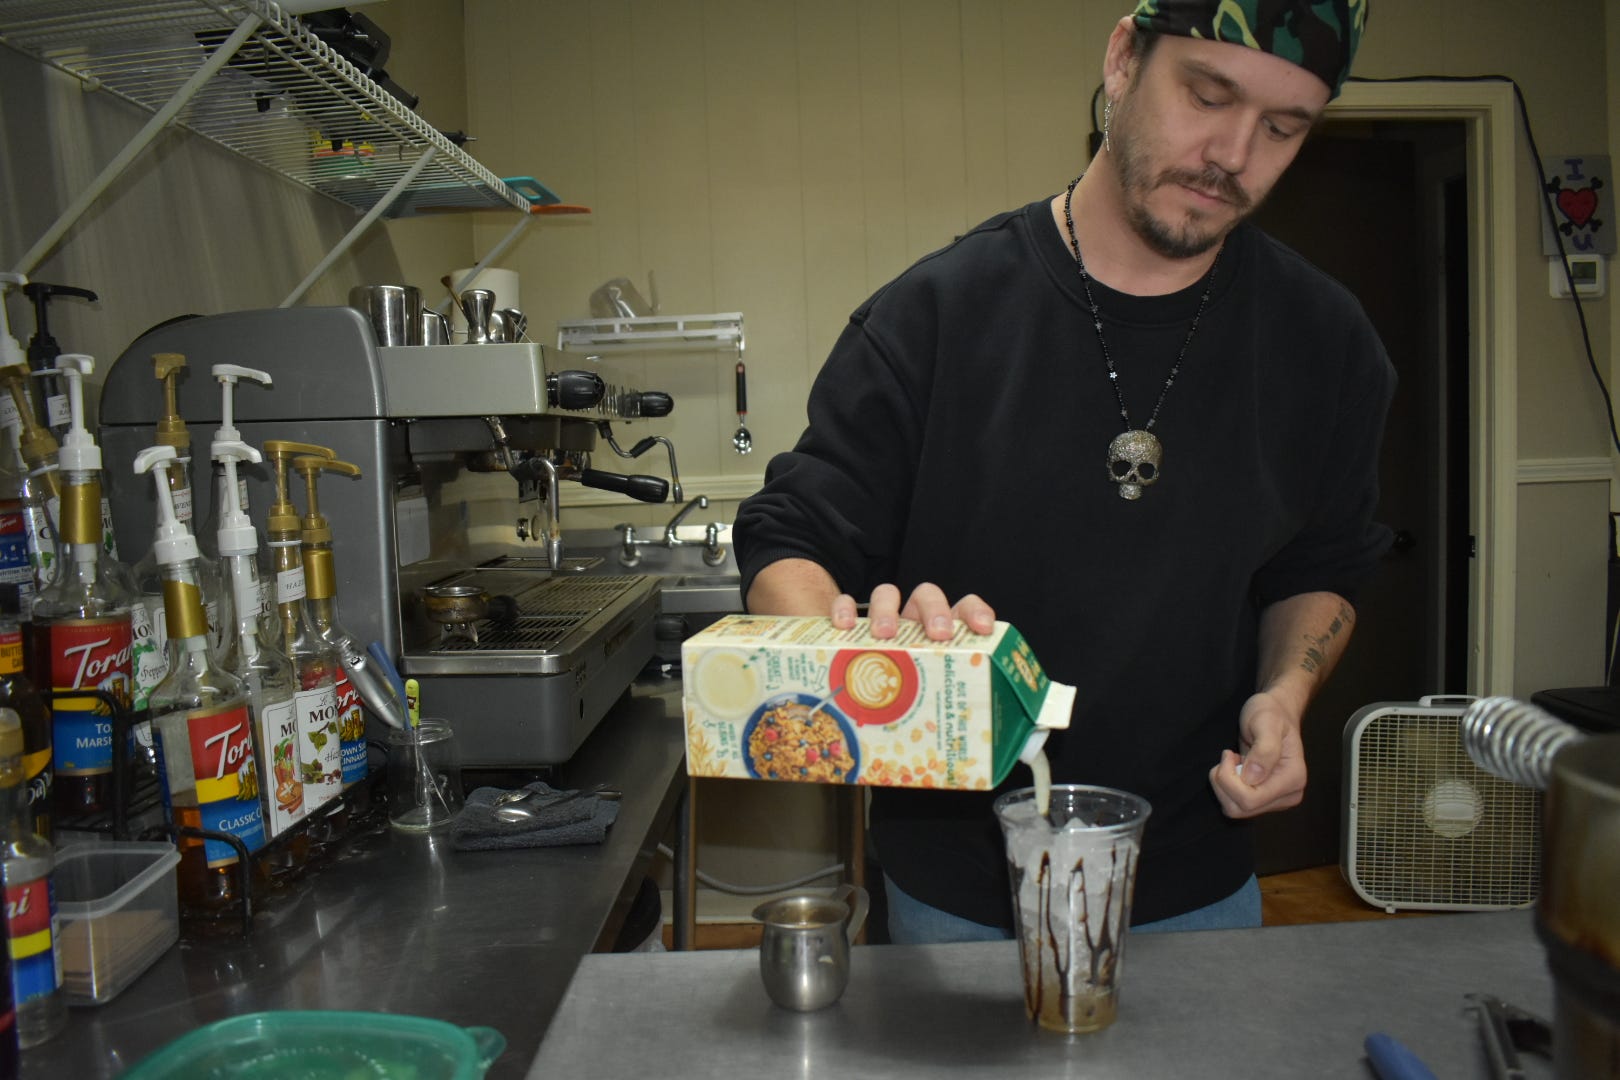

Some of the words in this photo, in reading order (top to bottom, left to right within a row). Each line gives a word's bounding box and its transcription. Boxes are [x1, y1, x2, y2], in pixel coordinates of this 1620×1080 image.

[1564, 158, 1585, 180] I
[944, 654, 956, 709] delicious
[945, 712, 955, 720] &
